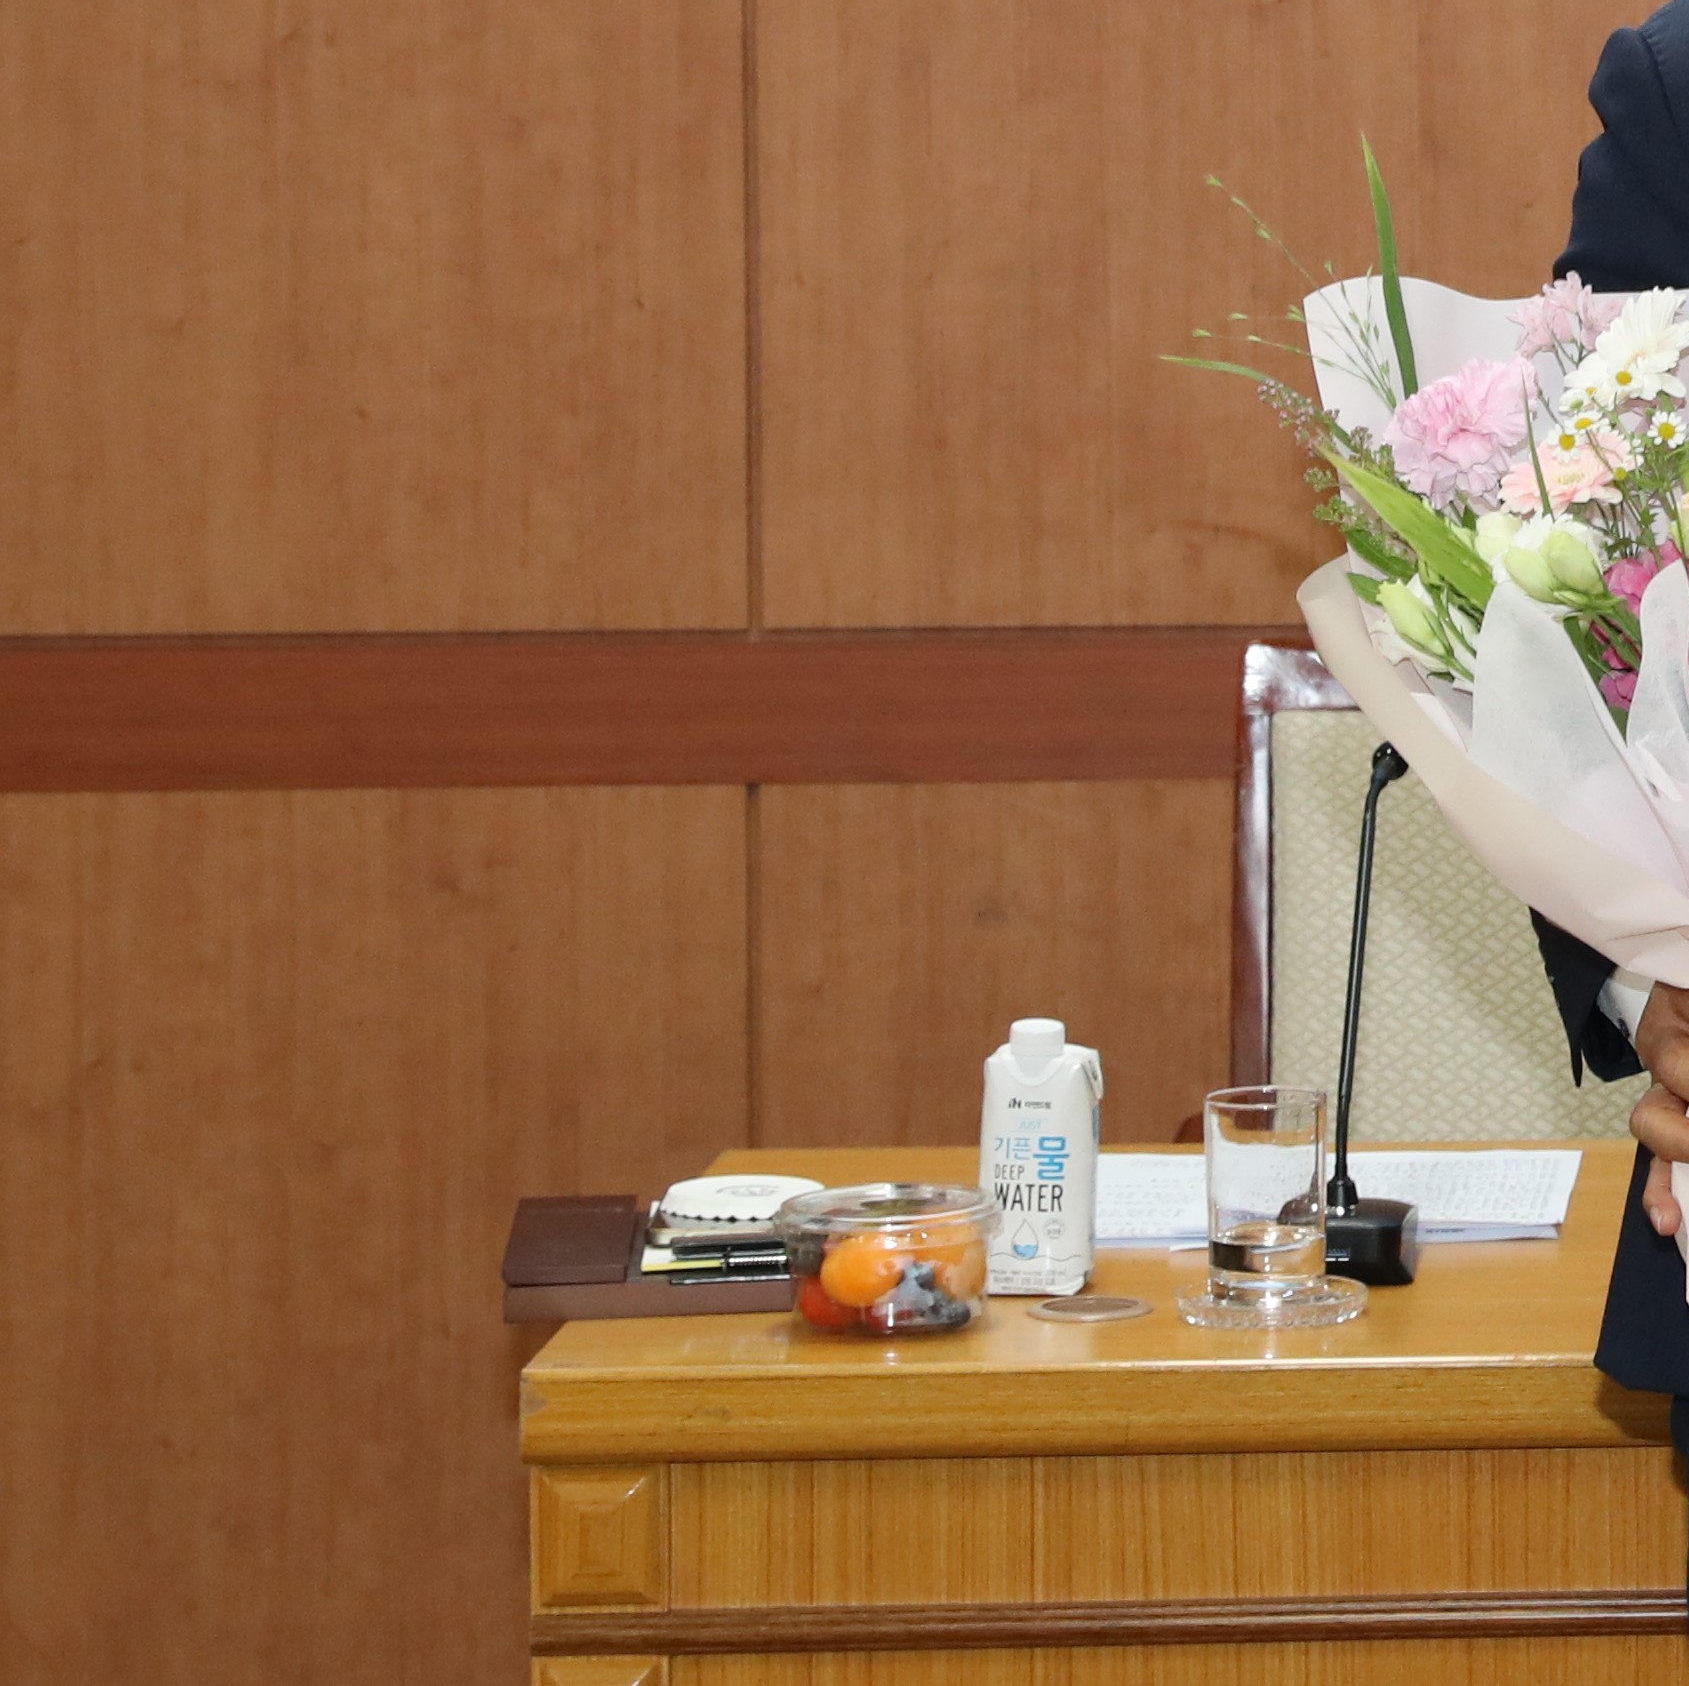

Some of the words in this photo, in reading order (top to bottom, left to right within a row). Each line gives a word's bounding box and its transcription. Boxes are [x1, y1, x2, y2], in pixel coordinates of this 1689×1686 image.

[994, 1136, 1032, 1162] 기픈
[1033, 1135, 1071, 1182] 물
[994, 1163, 1026, 1181] DEEP
[994, 1183, 1064, 1213] WATER
